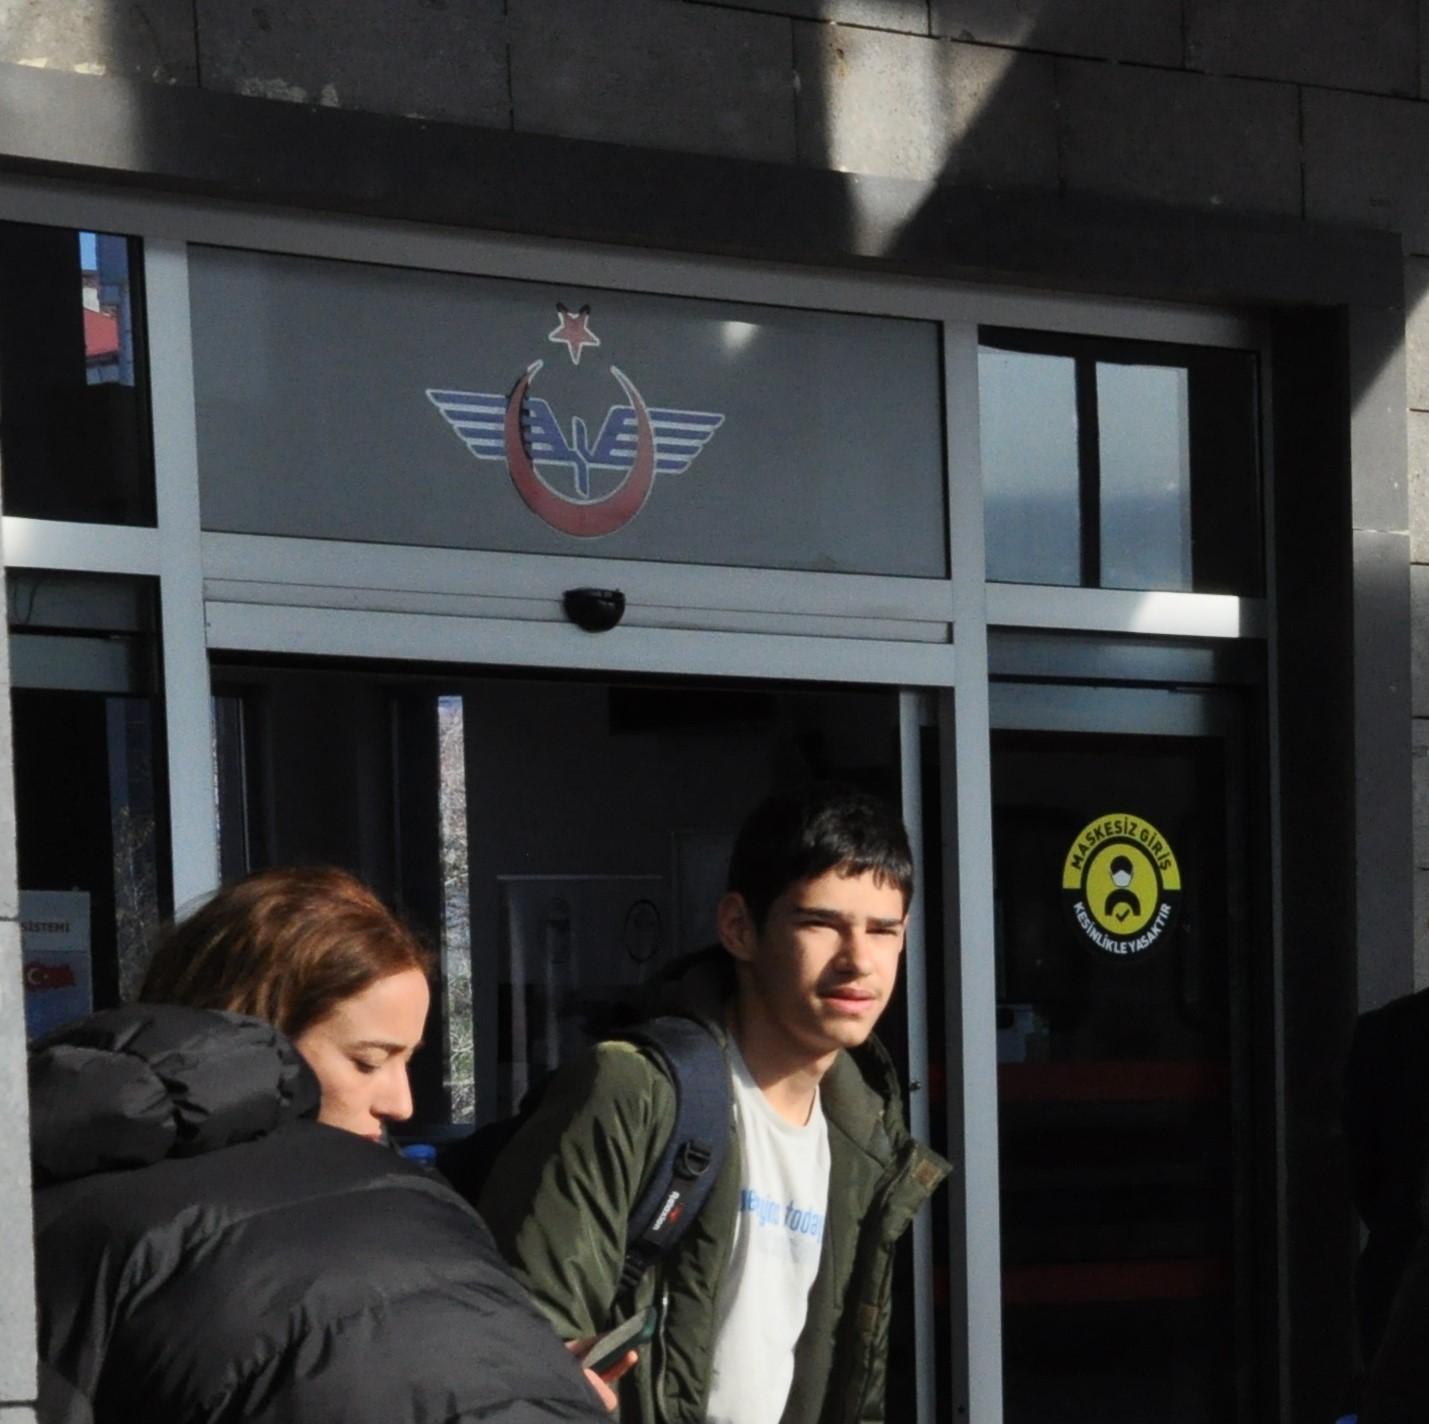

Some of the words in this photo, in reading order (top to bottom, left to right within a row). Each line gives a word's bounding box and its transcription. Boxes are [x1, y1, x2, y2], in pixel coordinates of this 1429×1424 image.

[1070, 816, 1138, 870] MASKESİZ
[1139, 828, 1172, 871] GİRİŞ
[1073, 901, 1127, 954] KESİNLİKLE
[1128, 902, 1172, 953] YASAKTIR
